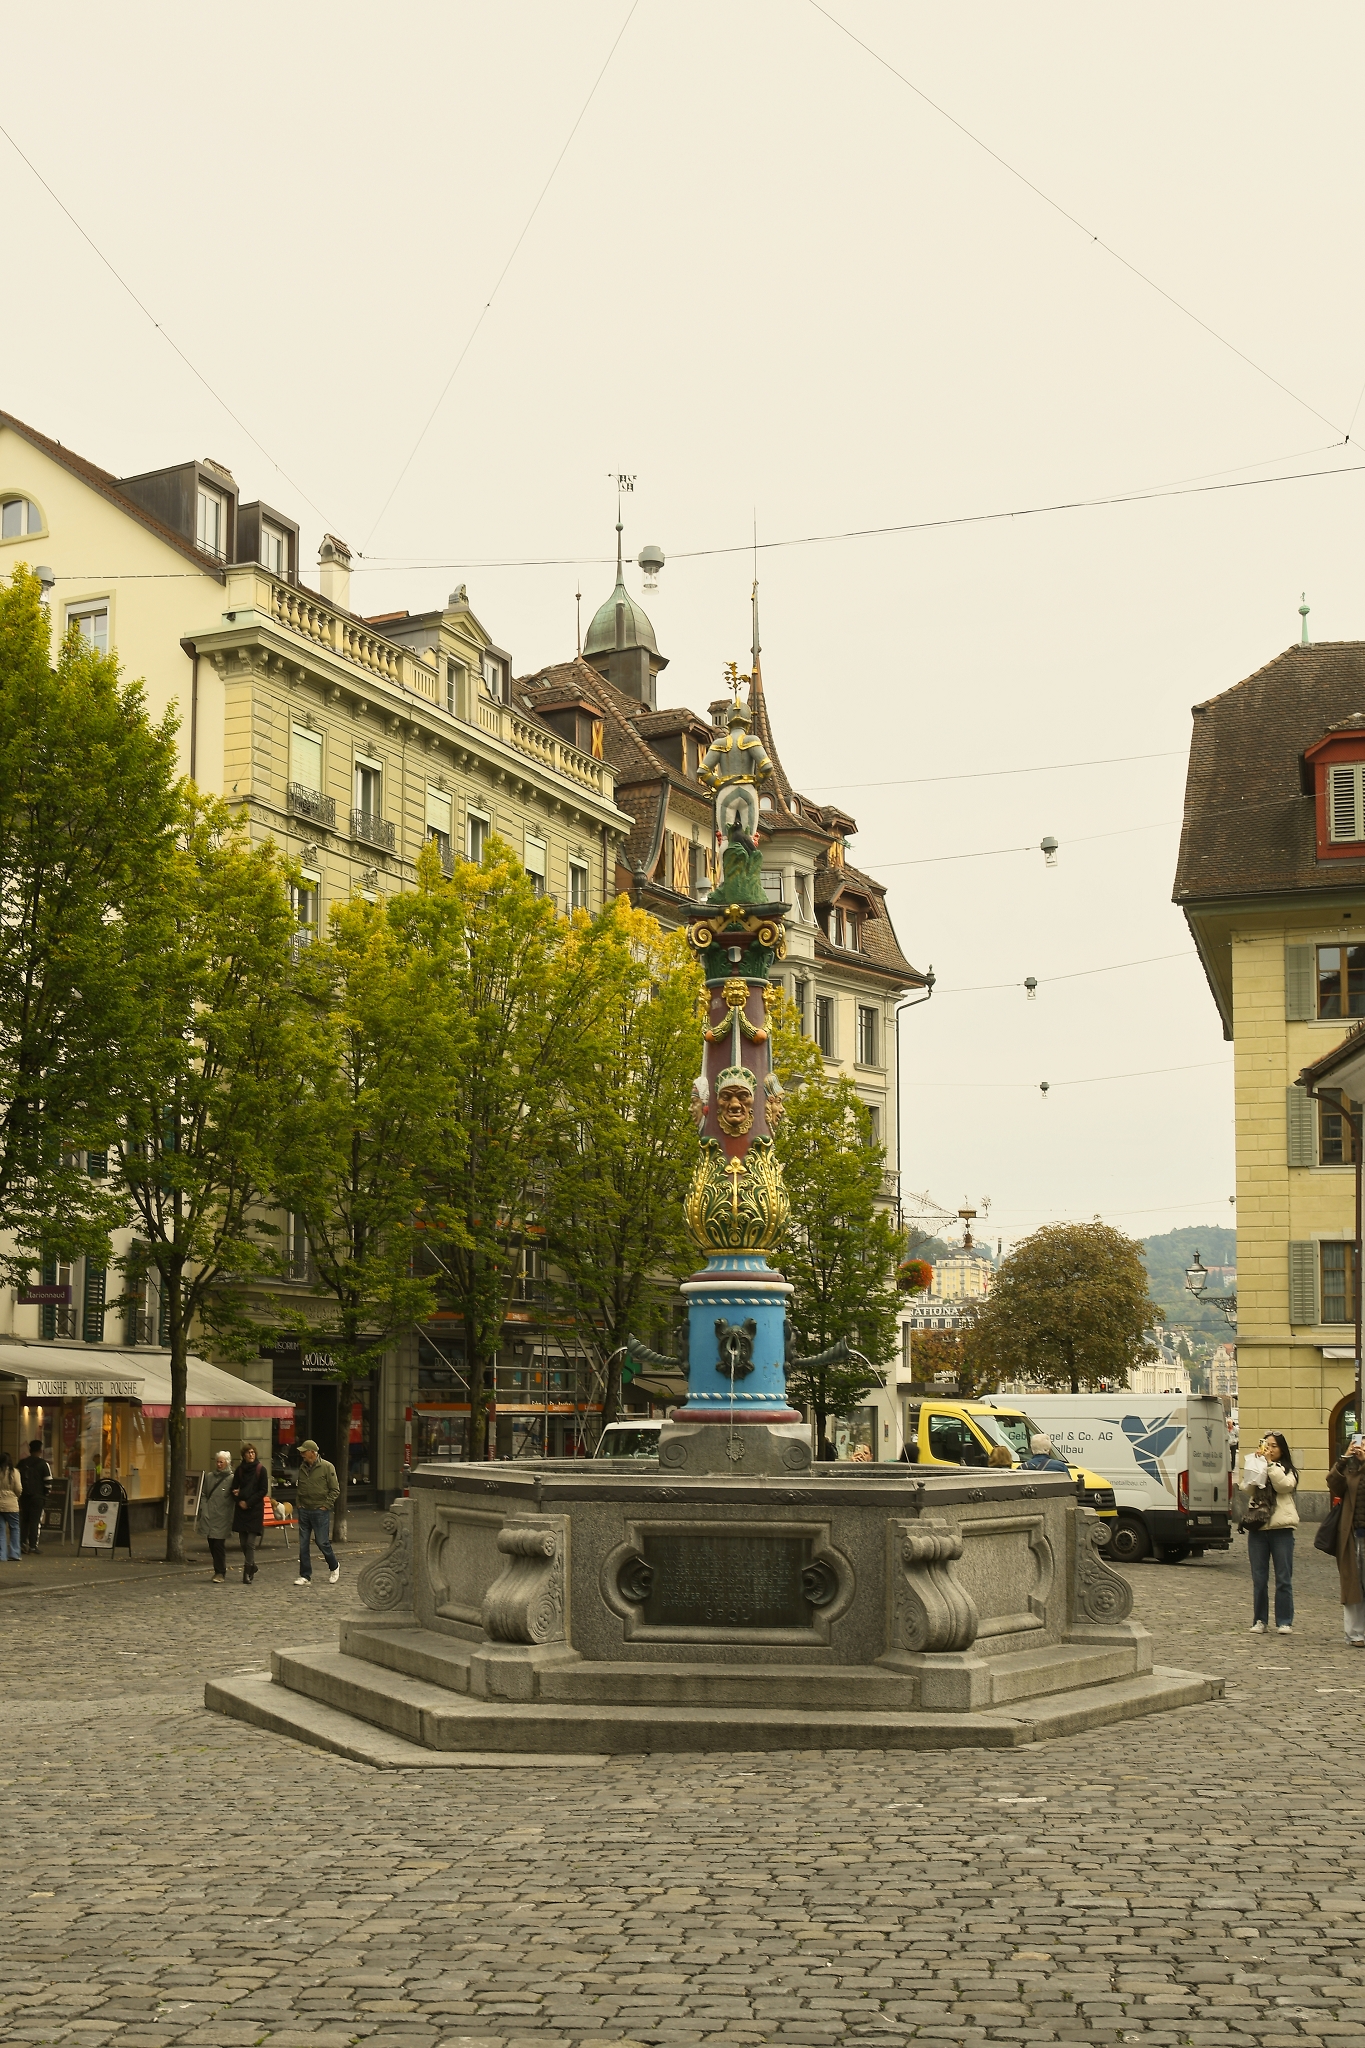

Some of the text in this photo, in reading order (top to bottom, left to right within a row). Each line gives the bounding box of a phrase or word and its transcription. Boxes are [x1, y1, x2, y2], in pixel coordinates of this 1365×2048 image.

[37, 1382, 137, 1395] POUSHE POUSHE POUSHE
[1008, 1432, 1028, 1441] Geb
[1067, 1431, 1076, 1441] &
[1078, 1432, 1094, 1441] Co.
[1098, 1432, 1113, 1441] AG
